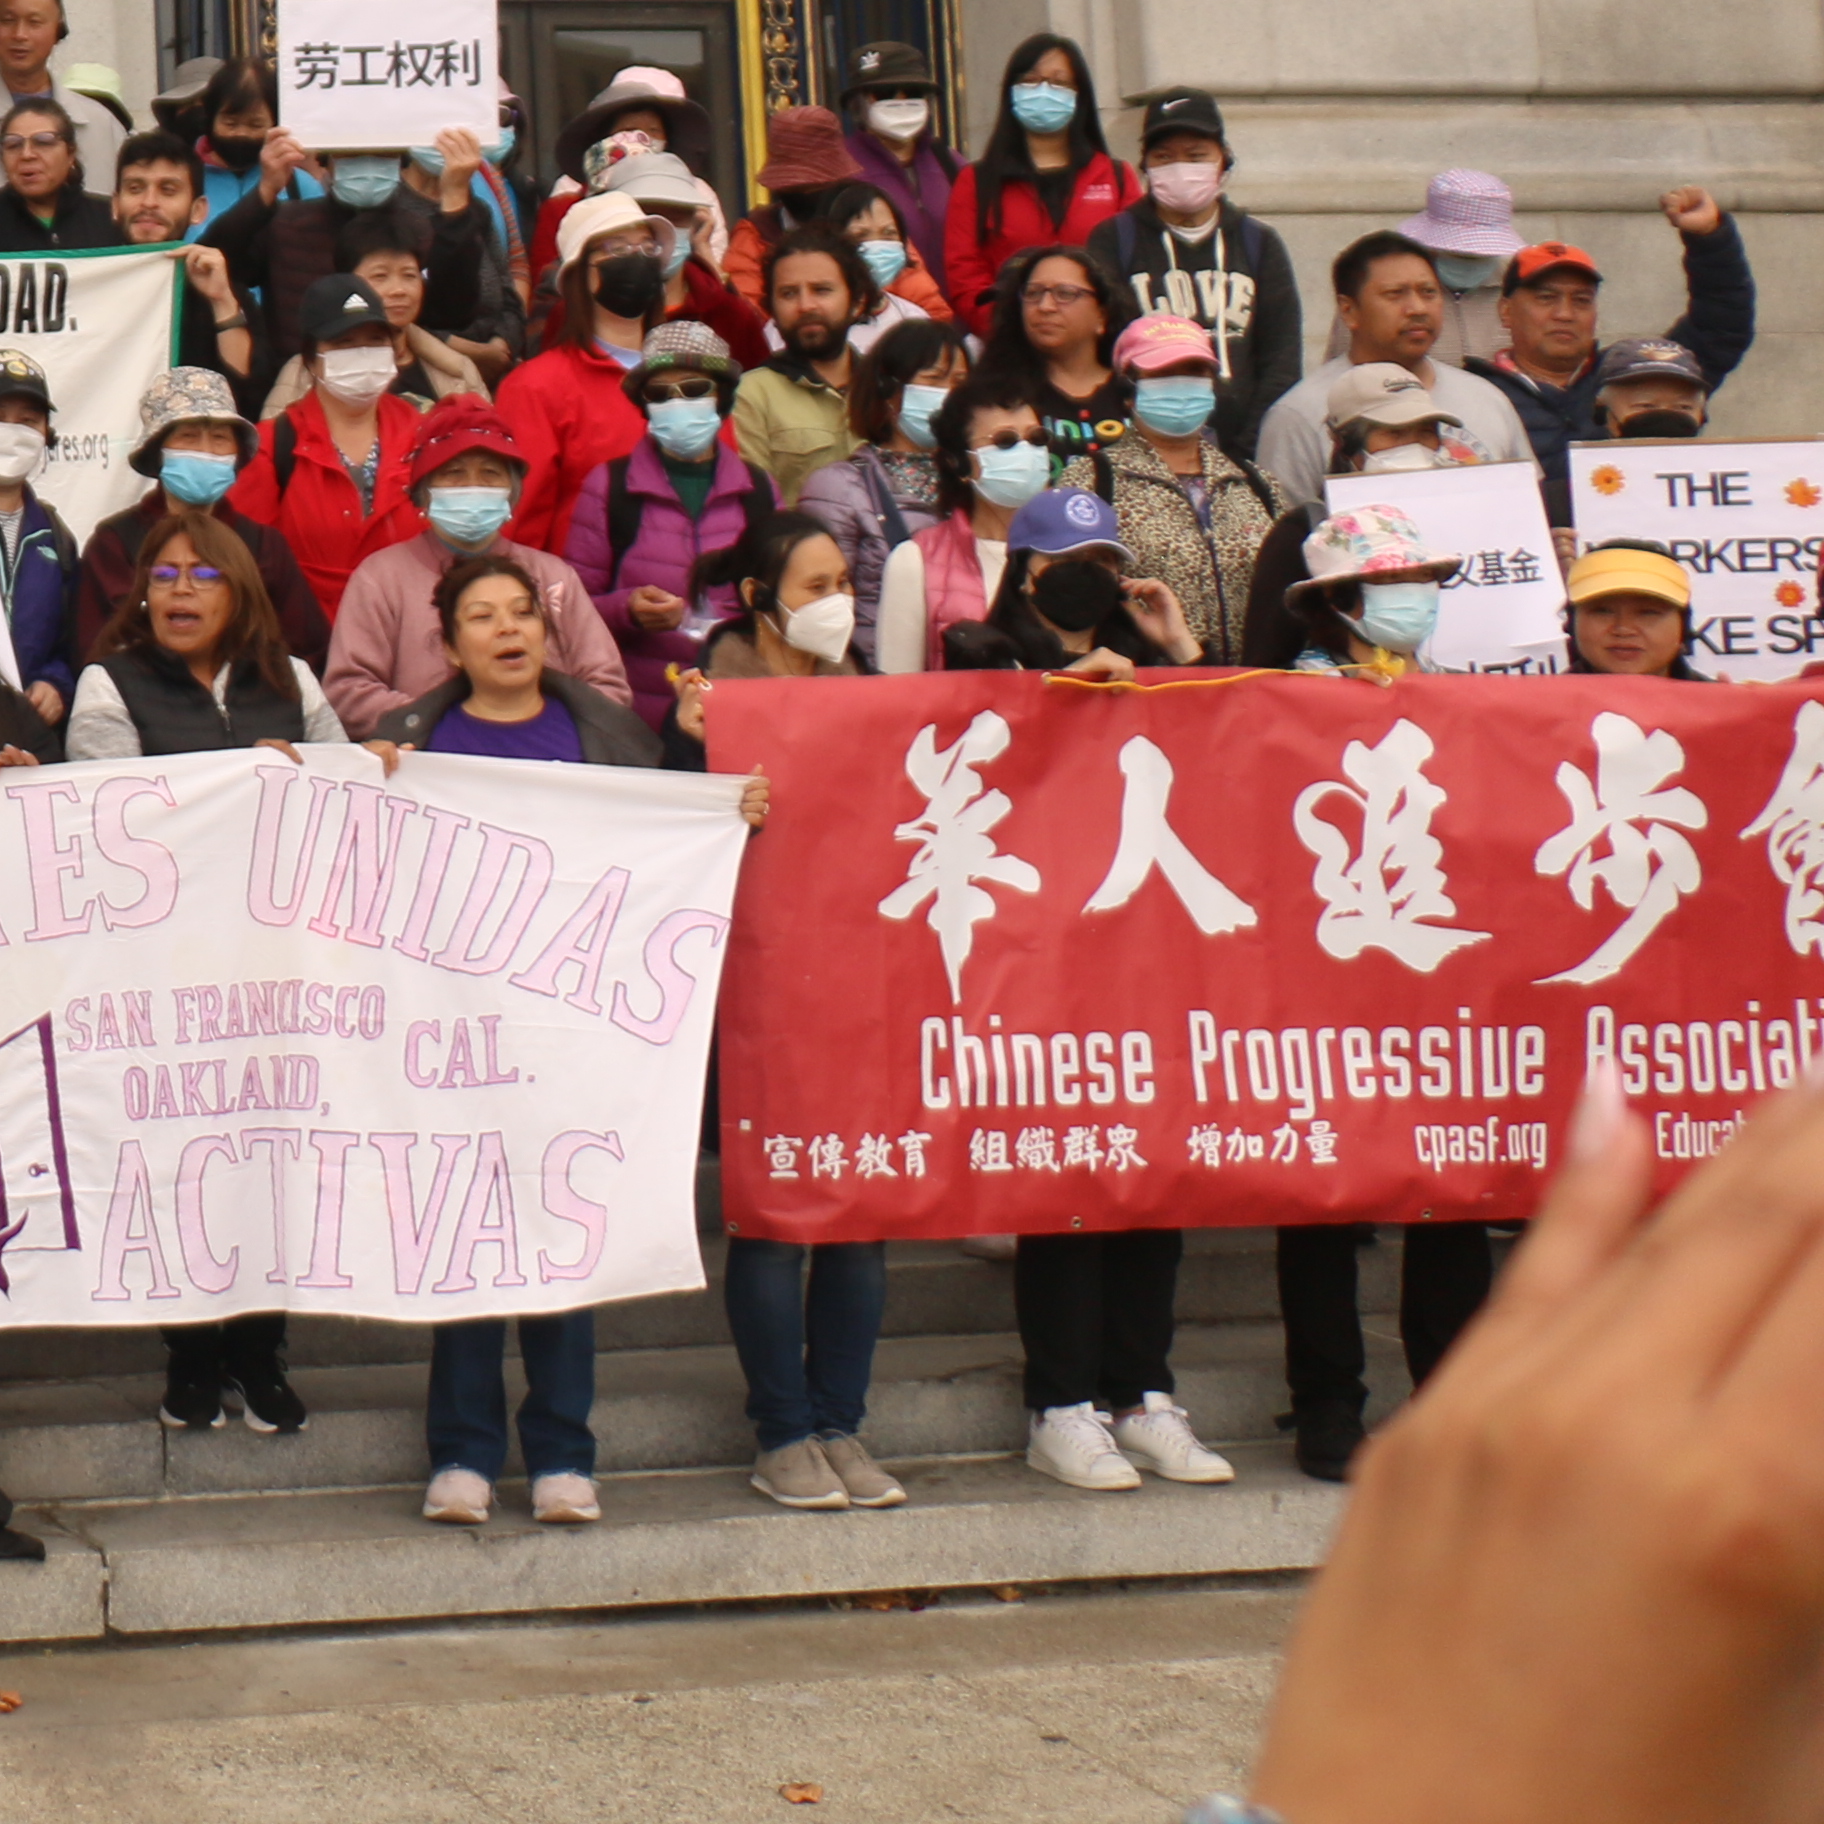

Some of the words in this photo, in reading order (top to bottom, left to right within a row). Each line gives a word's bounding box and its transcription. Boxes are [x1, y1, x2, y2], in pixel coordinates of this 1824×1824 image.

[293, 40, 482, 90] 劳工权利
[1655, 470, 1753, 507] THE
[1652, 536, 1822, 574] RKERS
[1681, 615, 1759, 656] KE
[246, 764, 731, 1048] UNIDAS
[65, 990, 158, 1053] SAN
[171, 978, 386, 1045] FRANCISCO
[403, 1013, 537, 1089] CAL.
[920, 1013, 1156, 1111] Chinese
[1187, 1005, 1547, 1120] Progressive
[122, 1053, 331, 1122] OAKLAND,
[762, 1129, 934, 1179] 宣傳教育
[1186, 1120, 1339, 1169] 增加力量
[91, 1127, 627, 1303] ACTIVAS
